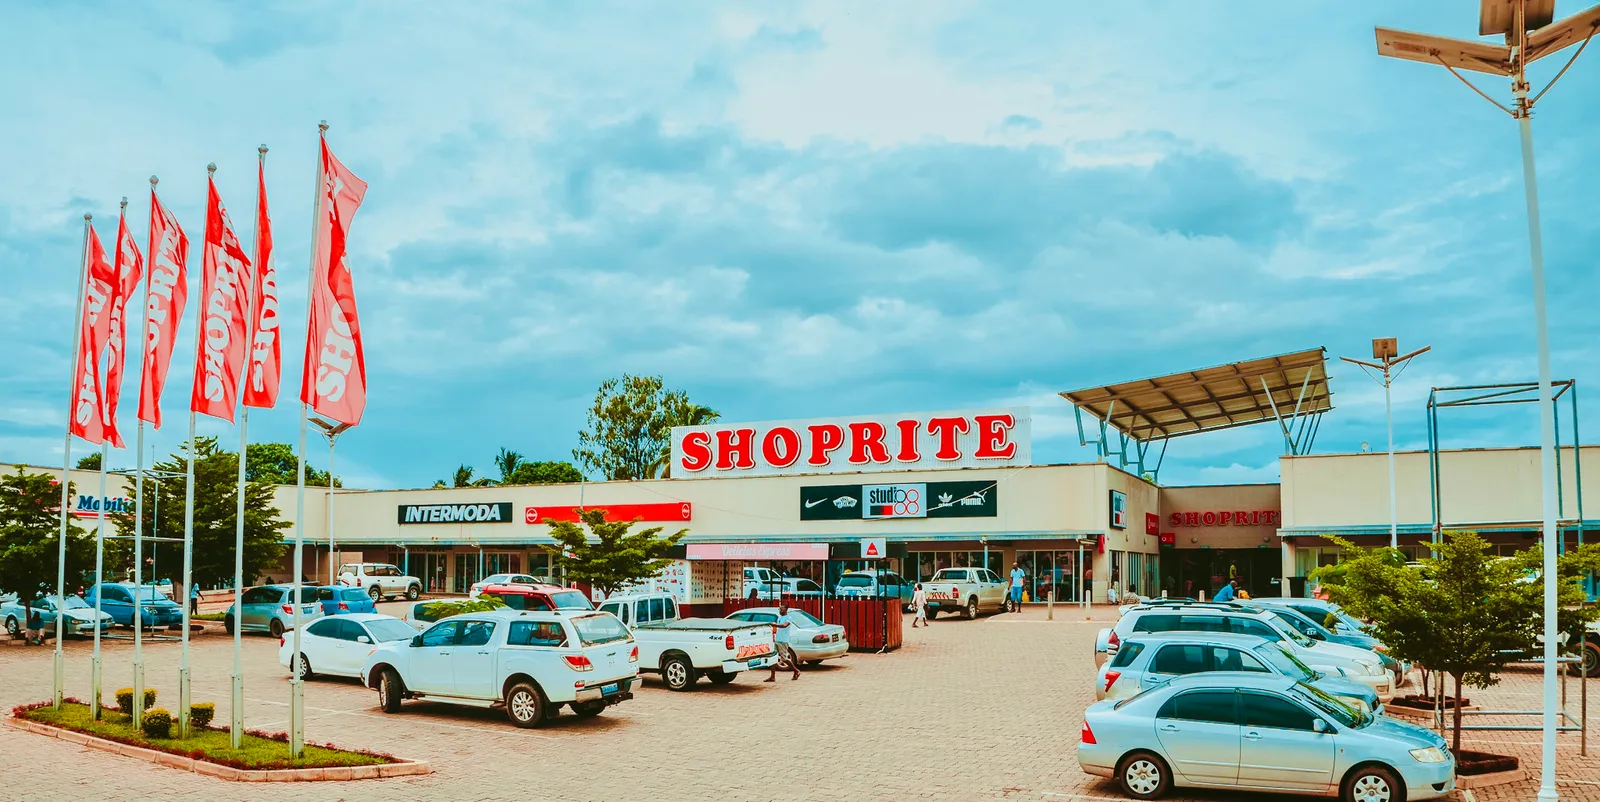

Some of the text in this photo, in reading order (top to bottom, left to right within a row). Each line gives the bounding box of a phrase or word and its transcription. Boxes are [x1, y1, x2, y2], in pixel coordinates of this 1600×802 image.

[681, 414, 1015, 471] SHOPRITE
[77, 495, 135, 512] Mobili
[405, 504, 501, 522] INTERMODA
[1170, 510, 1281, 527] SHOPRIT
